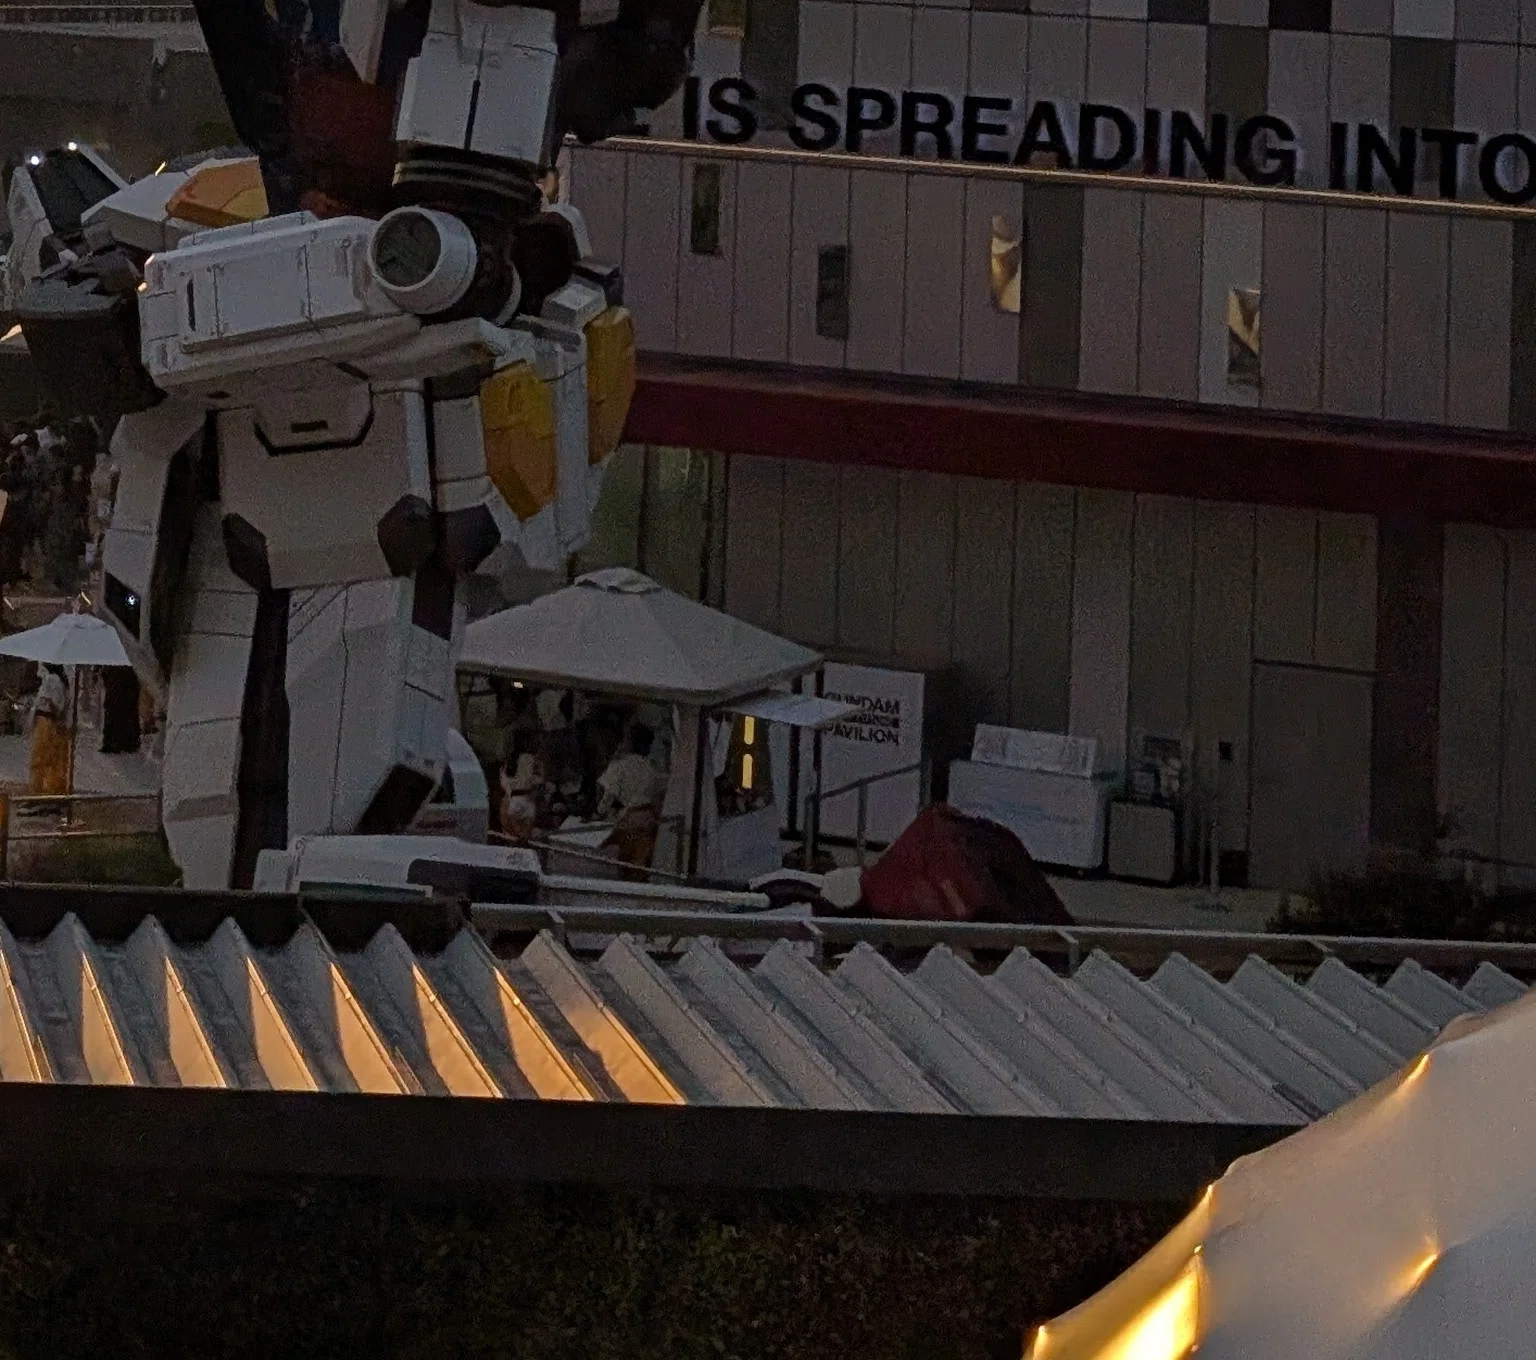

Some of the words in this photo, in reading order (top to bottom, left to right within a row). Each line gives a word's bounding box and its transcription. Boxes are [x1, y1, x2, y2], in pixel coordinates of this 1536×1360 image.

[683, 76, 757, 144] IS
[788, 83, 1297, 186] SPREADING
[1330, 121, 1536, 205] INTO
[823, 723, 899, 746] PAVILION
